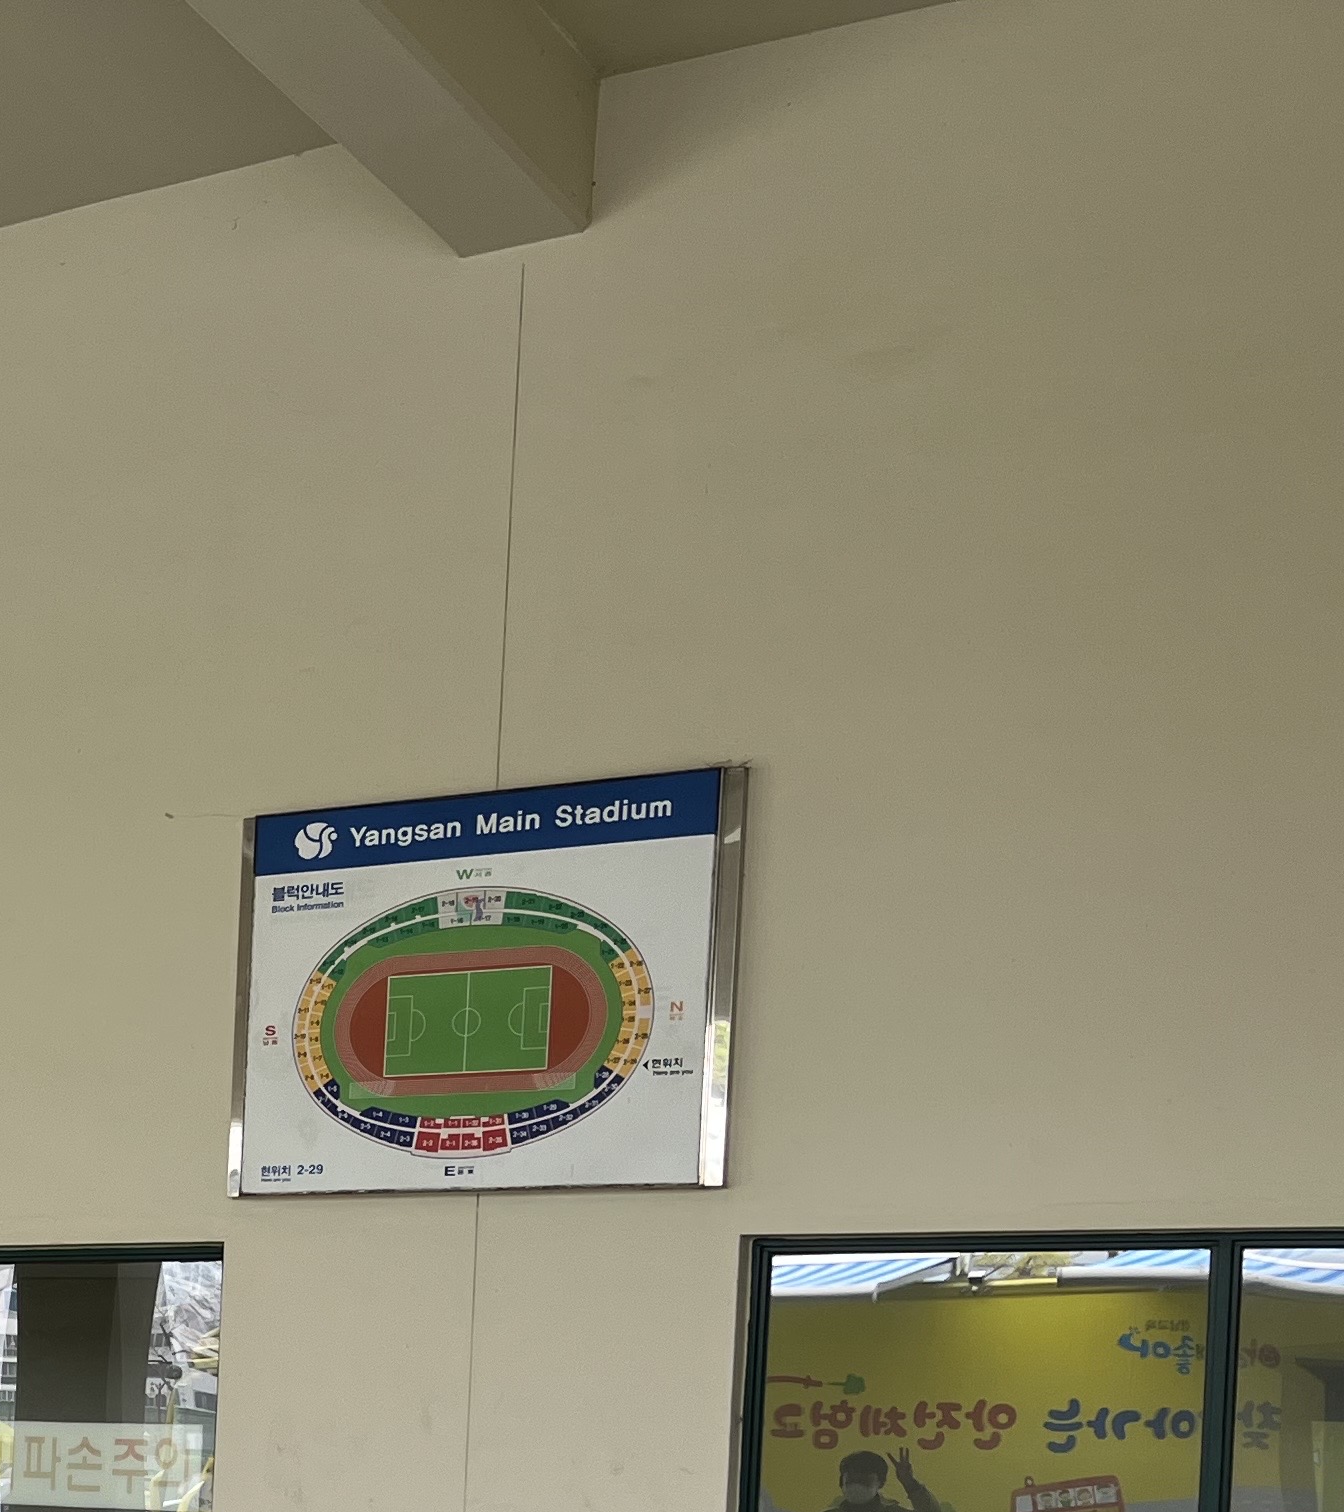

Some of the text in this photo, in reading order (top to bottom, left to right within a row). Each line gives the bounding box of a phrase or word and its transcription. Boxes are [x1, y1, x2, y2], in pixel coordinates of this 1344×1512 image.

[349, 799, 673, 848] Yangsan Main Stadium
[456, 868, 474, 880] W
[272, 882, 344, 902] 블럭안내도
[272, 901, 345, 913] Block Information
[670, 1001, 683, 1012] N
[265, 1025, 276, 1036] S
[652, 1058, 683, 1068] 현위치
[261, 1163, 324, 1177] 현위치 2-29
[444, 1165, 456, 1176] E
